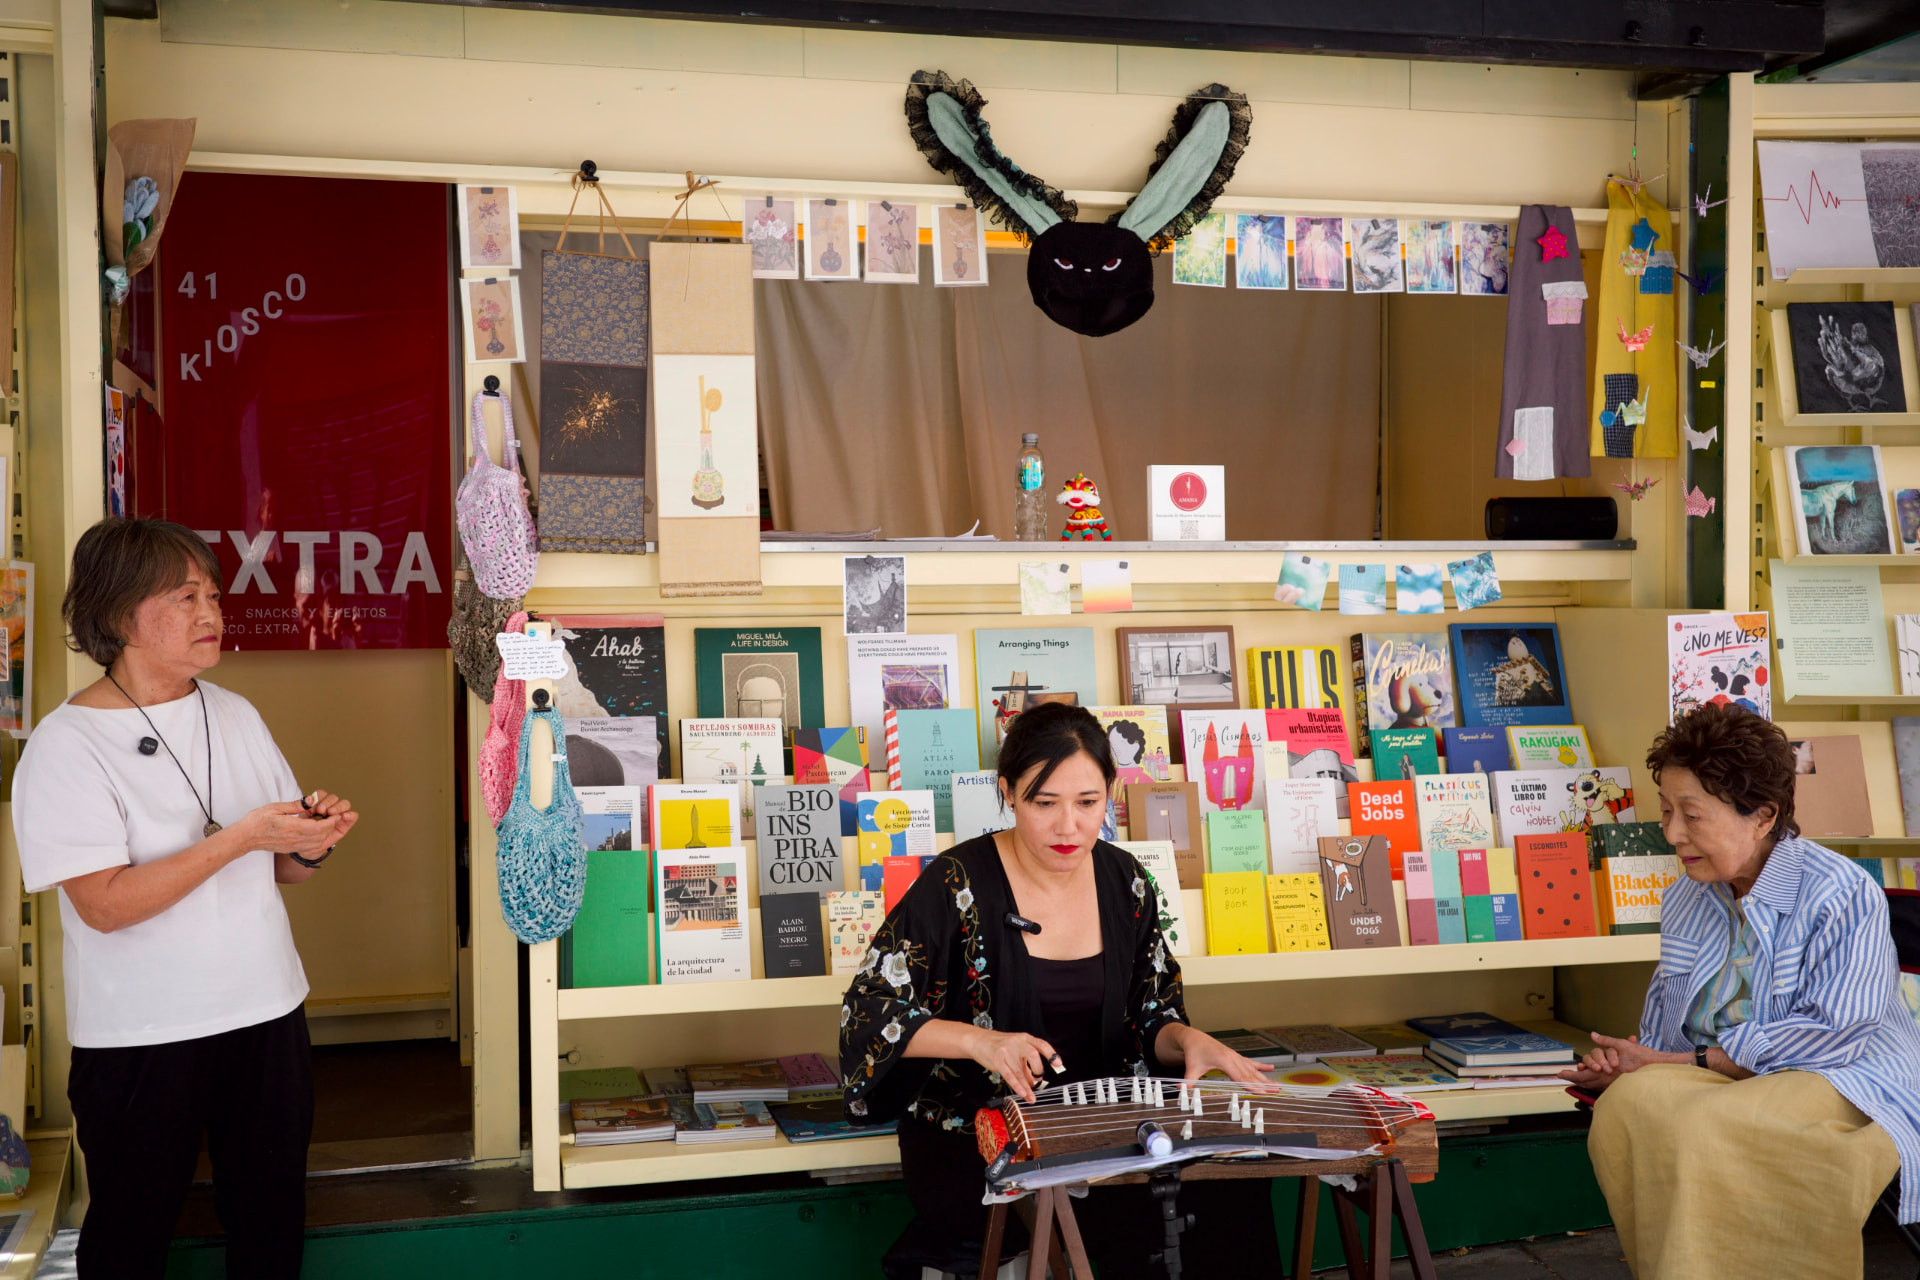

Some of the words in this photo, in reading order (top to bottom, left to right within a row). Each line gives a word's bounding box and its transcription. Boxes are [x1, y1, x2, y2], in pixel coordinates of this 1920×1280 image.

[178, 271, 217, 300] 41
[180, 273, 306, 381] KIOSCO
[246, 608, 299, 618] SNACKS
[308, 608, 316, 618] Y
[326, 607, 387, 618] EVENTOS
[222, 624, 299, 634] SCO.EXTRA
[590, 634, 645, 657] Ahab
[999, 640, 1041, 649] Arranging
[1043, 639, 1070, 648] Things
[1683, 631, 1711, 652] ¿NO
[1714, 630, 1732, 653] ME
[1735, 627, 1766, 644] VES?
[1369, 639, 1446, 697] Cornelius
[1519, 736, 1580, 749] RAKUGAKI
[957, 776, 996, 786] Artists
[1511, 784, 1519, 792] EL
[1520, 782, 1547, 791] ÚLTIMO
[787, 789, 834, 812] BIO
[1360, 790, 1404, 806] Dead
[1514, 792, 1535, 801] LIBRO
[1537, 792, 1547, 800] DE
[1361, 806, 1405, 821] Jobs
[766, 813, 811, 836] INS
[774, 837, 839, 860] PIRA
[1529, 841, 1568, 850] ESCONDITES
[769, 858, 834, 884] CIÓN
[1612, 857, 1677, 874] AGENDA
[1613, 872, 1677, 891] Blackie
[1224, 886, 1248, 896] BOOK
[1614, 890, 1662, 907] Book
[1225, 900, 1249, 910] BOOK
[780, 918, 804, 926] ALAIN
[1350, 915, 1383, 927] UNDER
[778, 925, 808, 934] BADIOU
[1356, 926, 1380, 936] DOGS
[780, 936, 807, 944] NEGRO
[667, 958, 676, 966] La
[677, 957, 725, 967] arquitectura
[667, 968, 677, 976] de
[678, 967, 685, 975] la
[686, 966, 712, 975] ciudad
